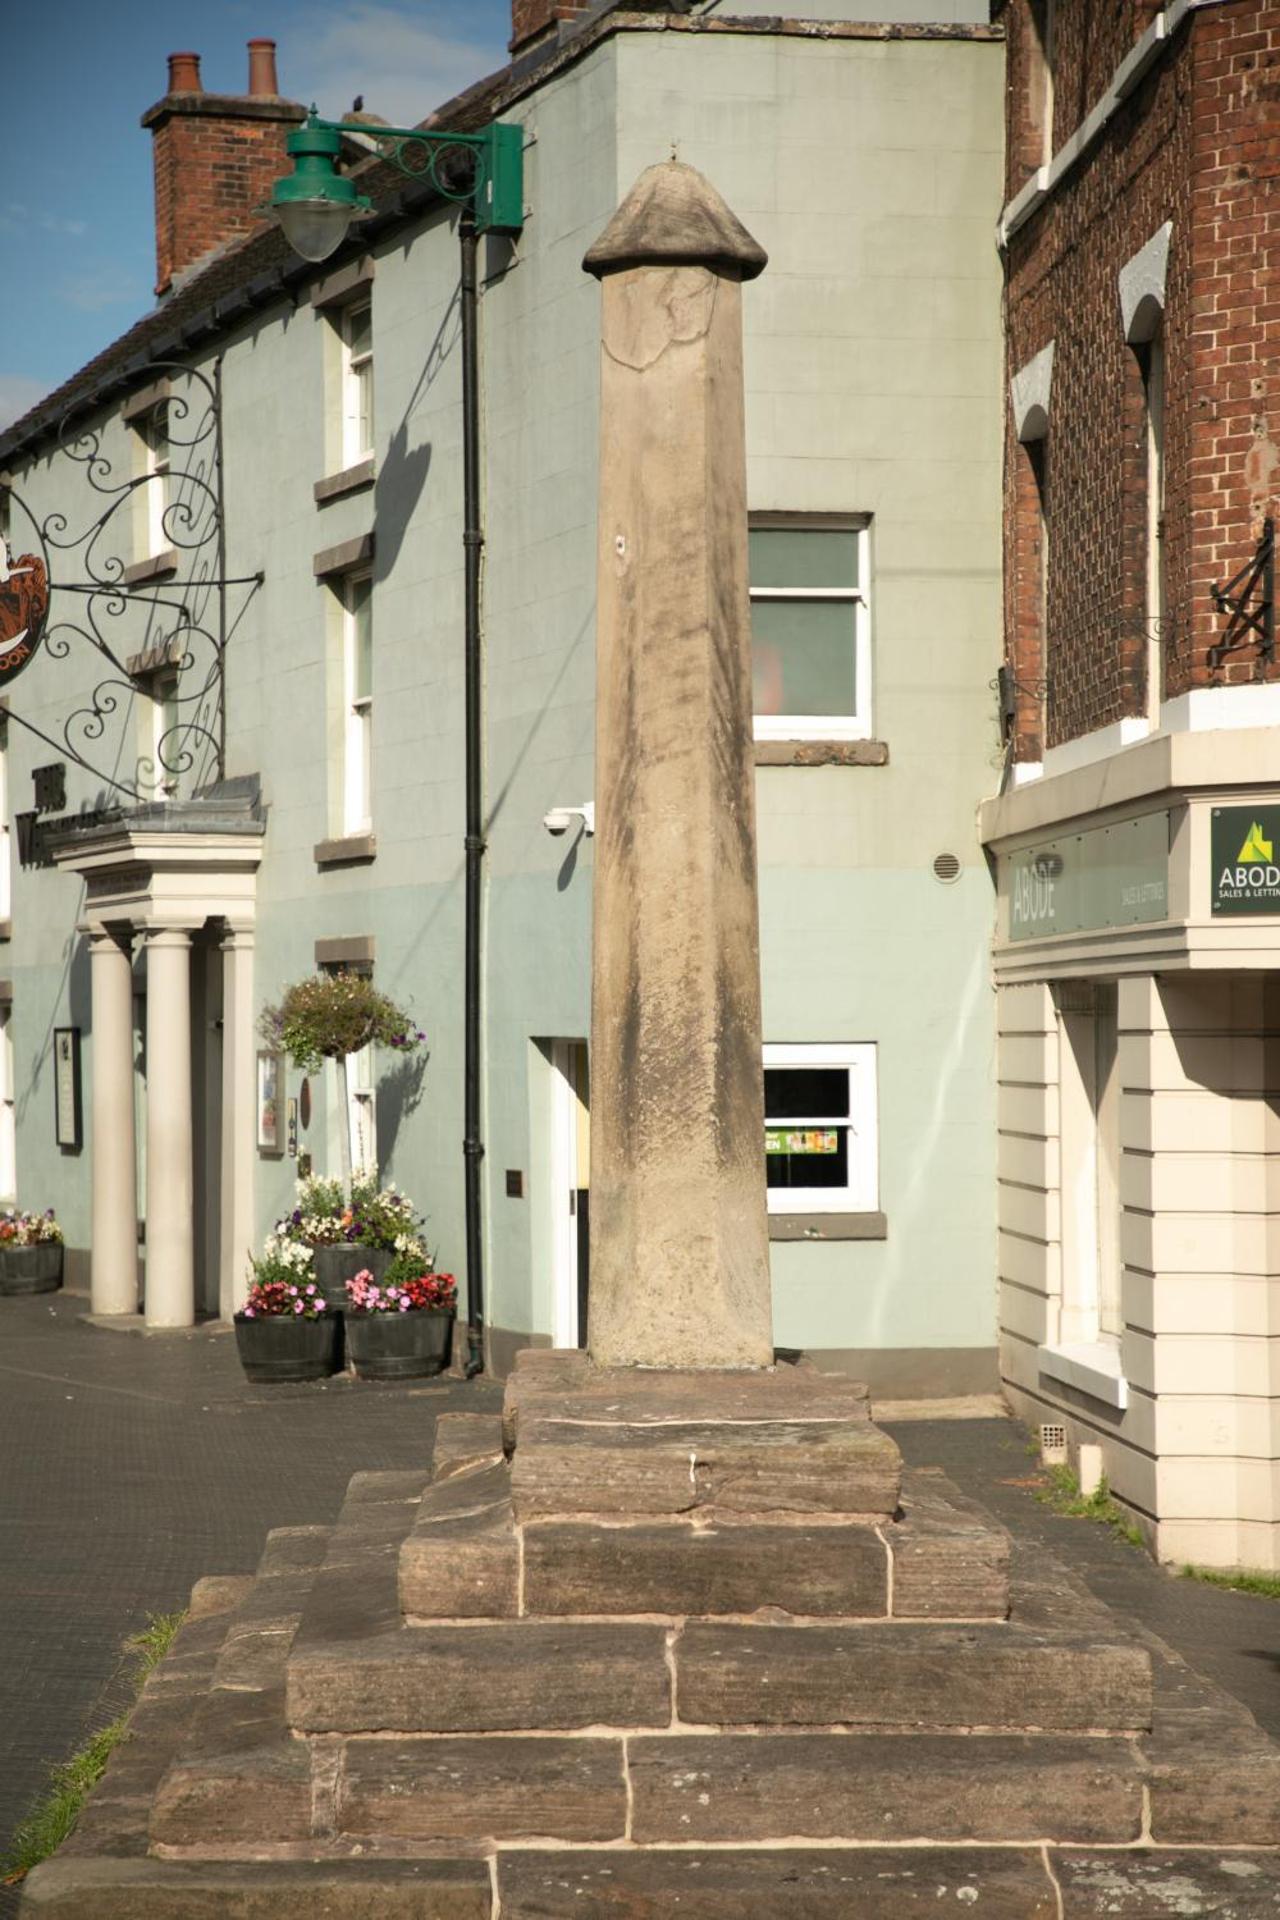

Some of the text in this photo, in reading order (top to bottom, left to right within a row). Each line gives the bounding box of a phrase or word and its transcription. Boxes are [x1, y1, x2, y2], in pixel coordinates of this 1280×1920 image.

[1219, 866, 1280, 888] ABOD
[1014, 861, 1055, 920] ABODE
[1219, 889, 1242, 898] SALES
[1245, 889, 1251, 897] &
